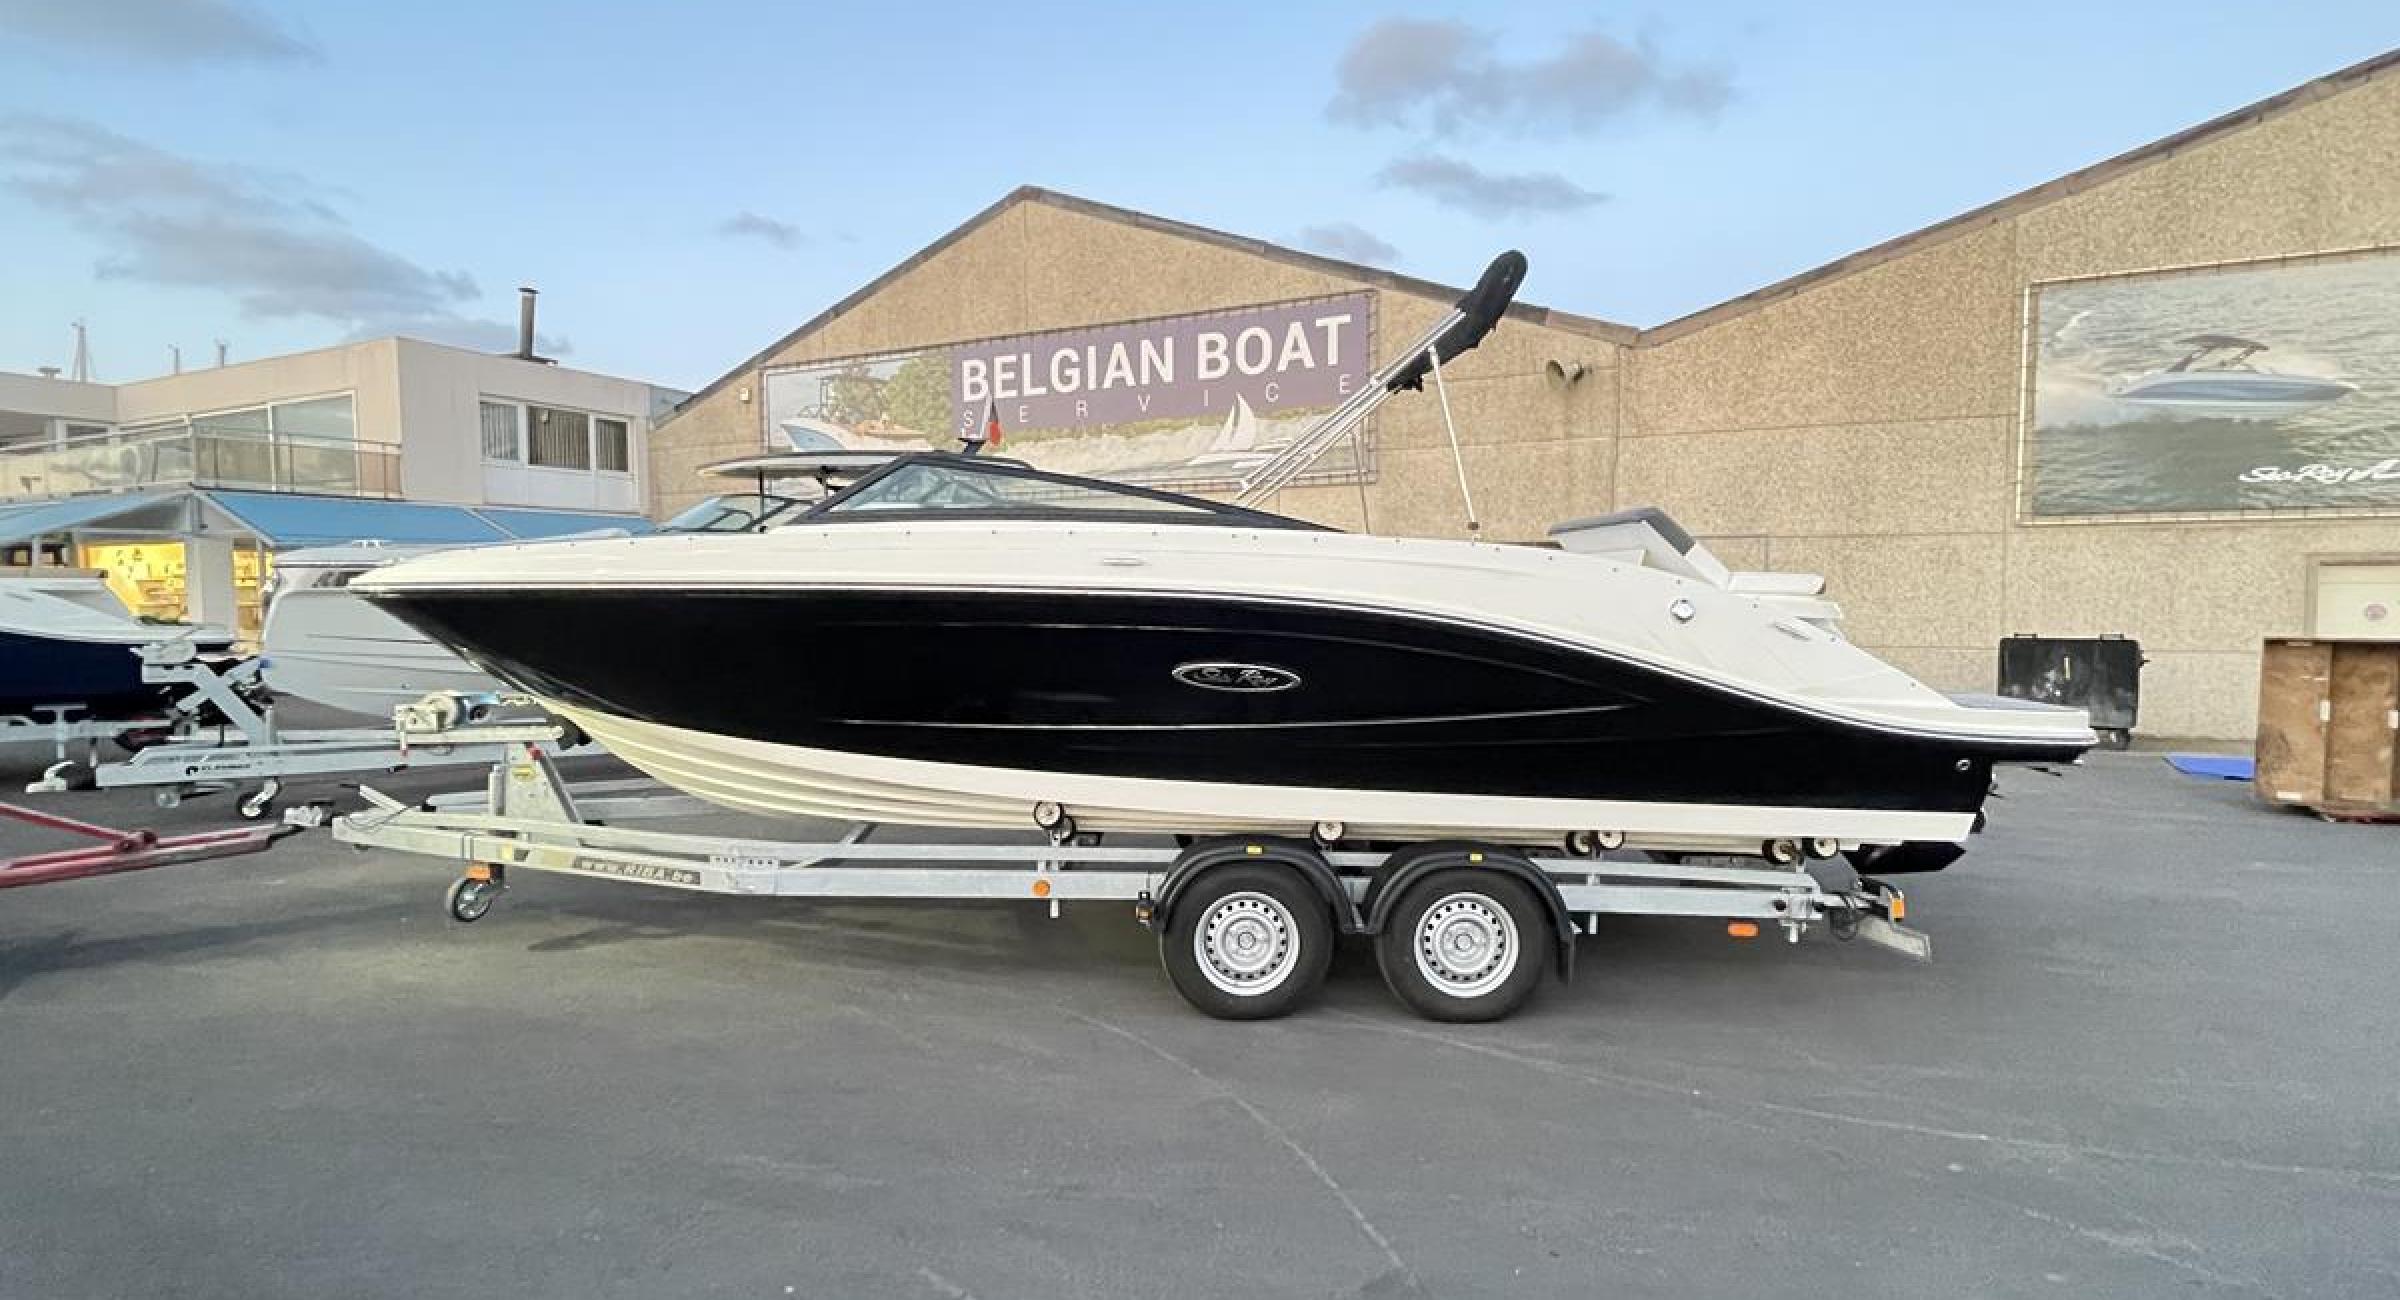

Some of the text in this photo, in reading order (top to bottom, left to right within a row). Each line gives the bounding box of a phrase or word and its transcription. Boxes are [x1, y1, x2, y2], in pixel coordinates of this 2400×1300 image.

[961, 313, 1352, 402] BELGIAN BOAT
[963, 373, 1352, 428] SERVICE
